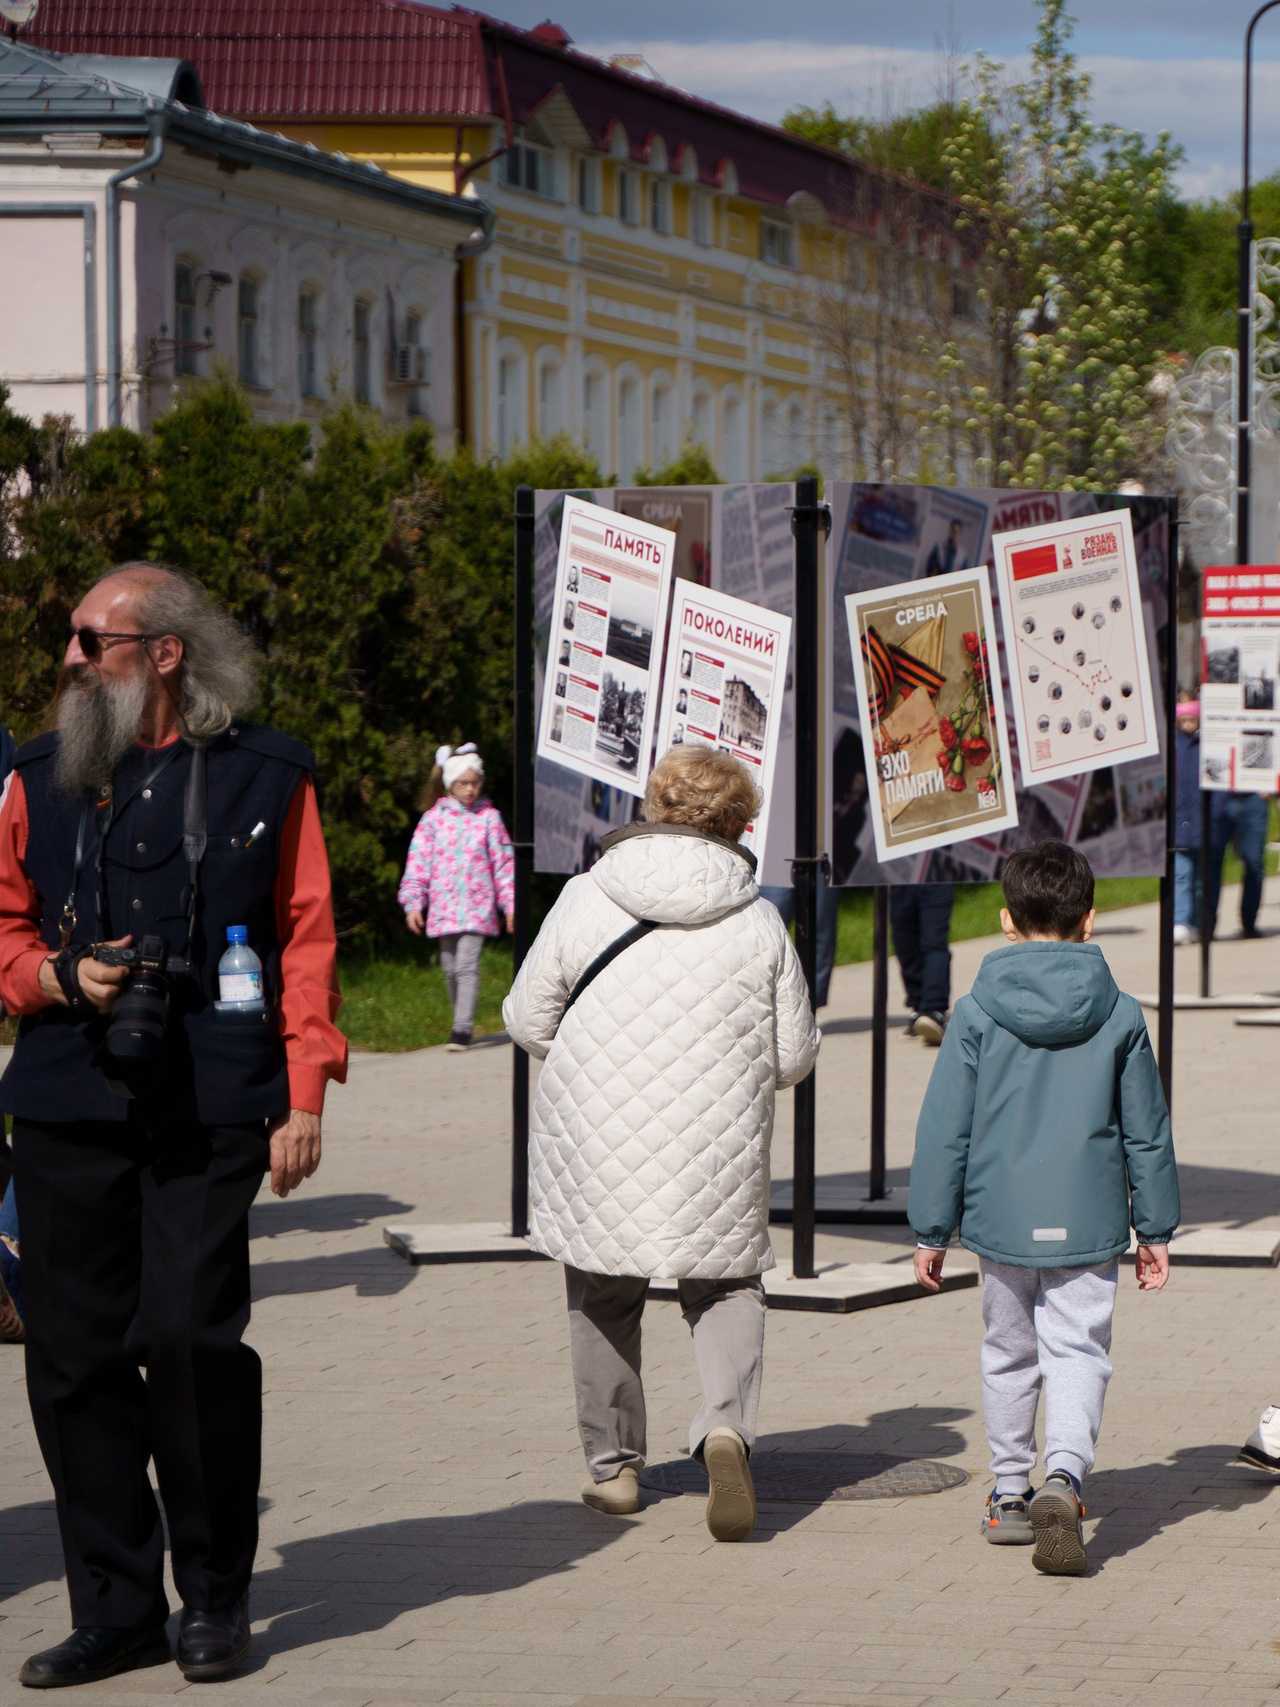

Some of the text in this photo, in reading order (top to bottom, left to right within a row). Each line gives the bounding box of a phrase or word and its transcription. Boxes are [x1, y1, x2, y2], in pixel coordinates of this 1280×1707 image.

[604, 529, 661, 565] ПАМЯТЬ
[1081, 542, 1118, 560] ВОЕННАЯ
[1084, 531, 1117, 547] РЯЗАНЬ
[895, 601, 948, 626] СРЕДА
[683, 607, 775, 657] ПОКОЛЕНИЙ
[881, 750, 910, 779] ЭХО
[884, 767, 945, 805] ПАМЯТИ
[977, 789, 997, 810] №8
[716, 1483, 744, 1494] ecco
